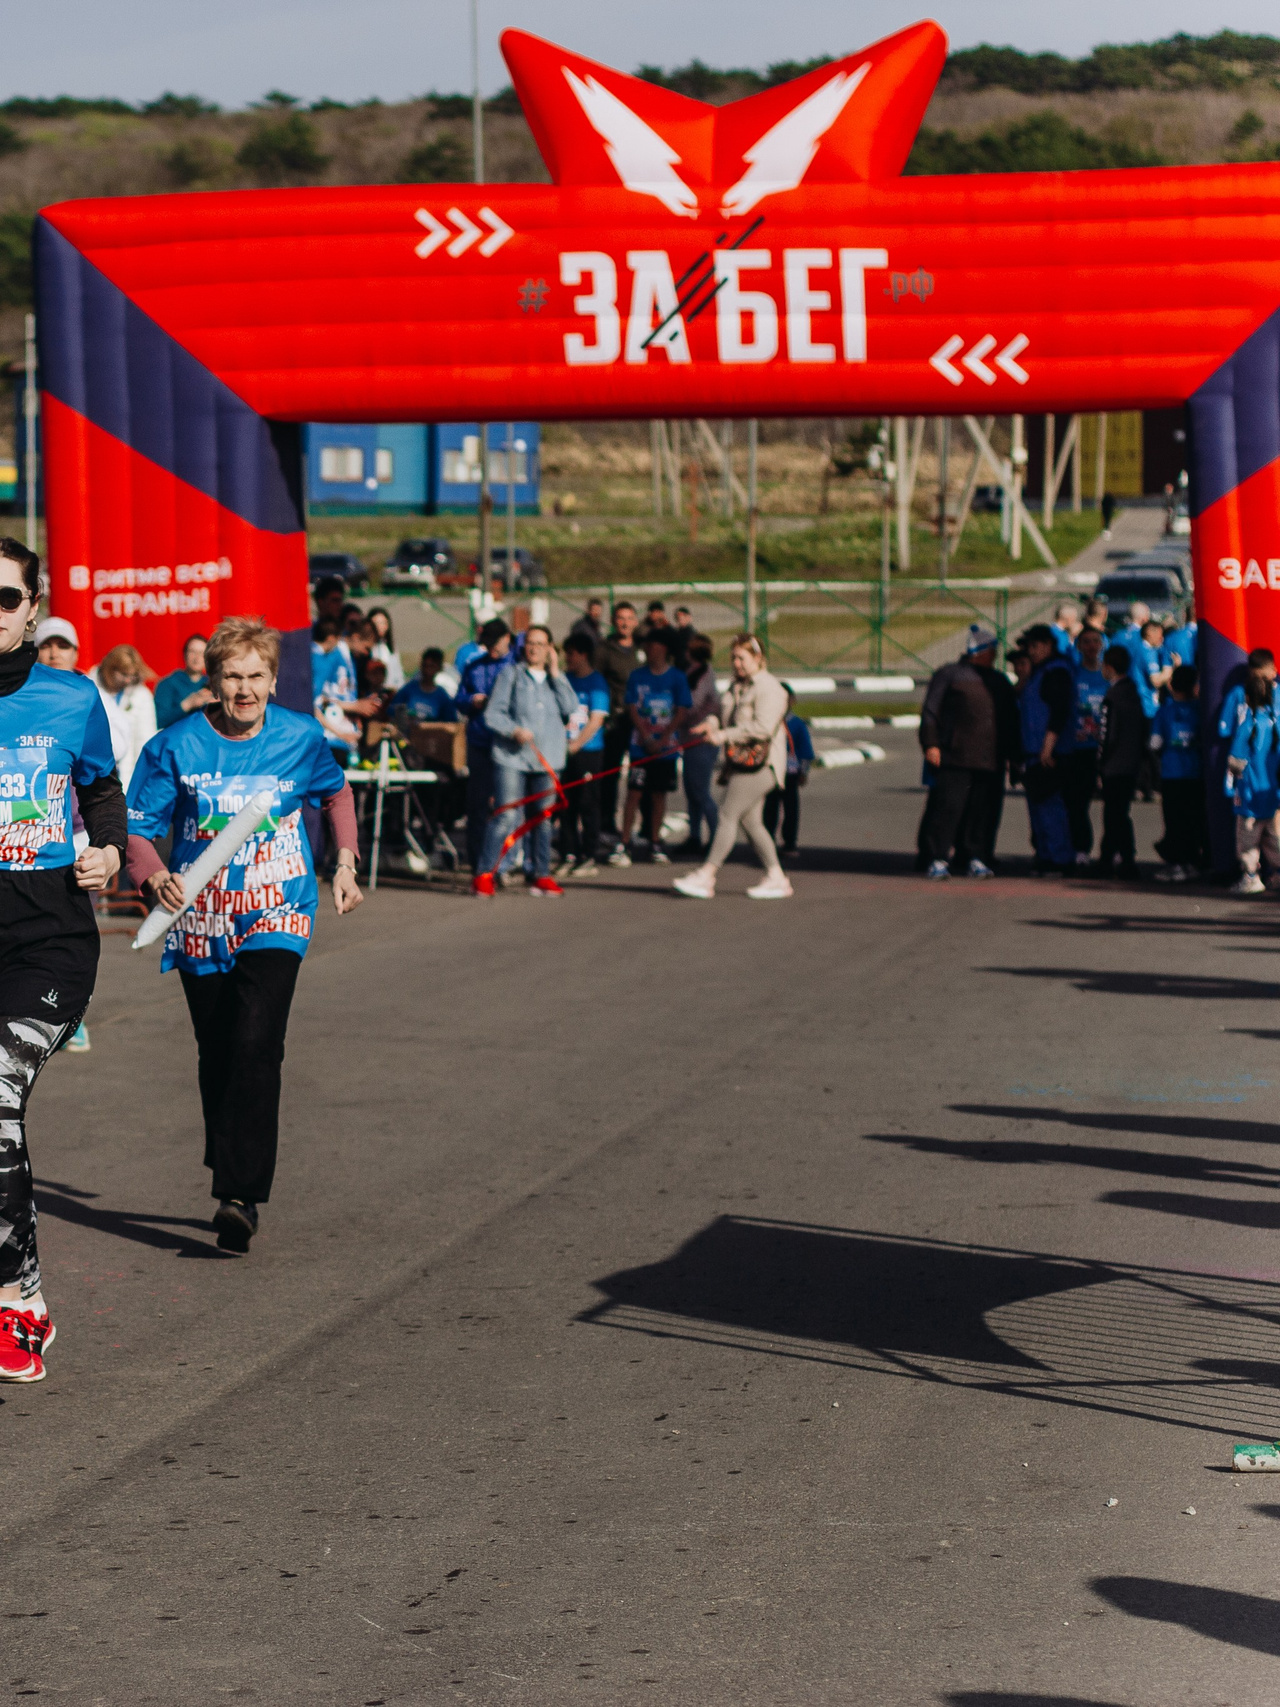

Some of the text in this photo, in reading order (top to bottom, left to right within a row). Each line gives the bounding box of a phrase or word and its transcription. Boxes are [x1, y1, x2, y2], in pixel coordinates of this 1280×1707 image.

[70, 557, 232, 592] В ритме всей
[93, 587, 210, 619] СТРАНЫ!
